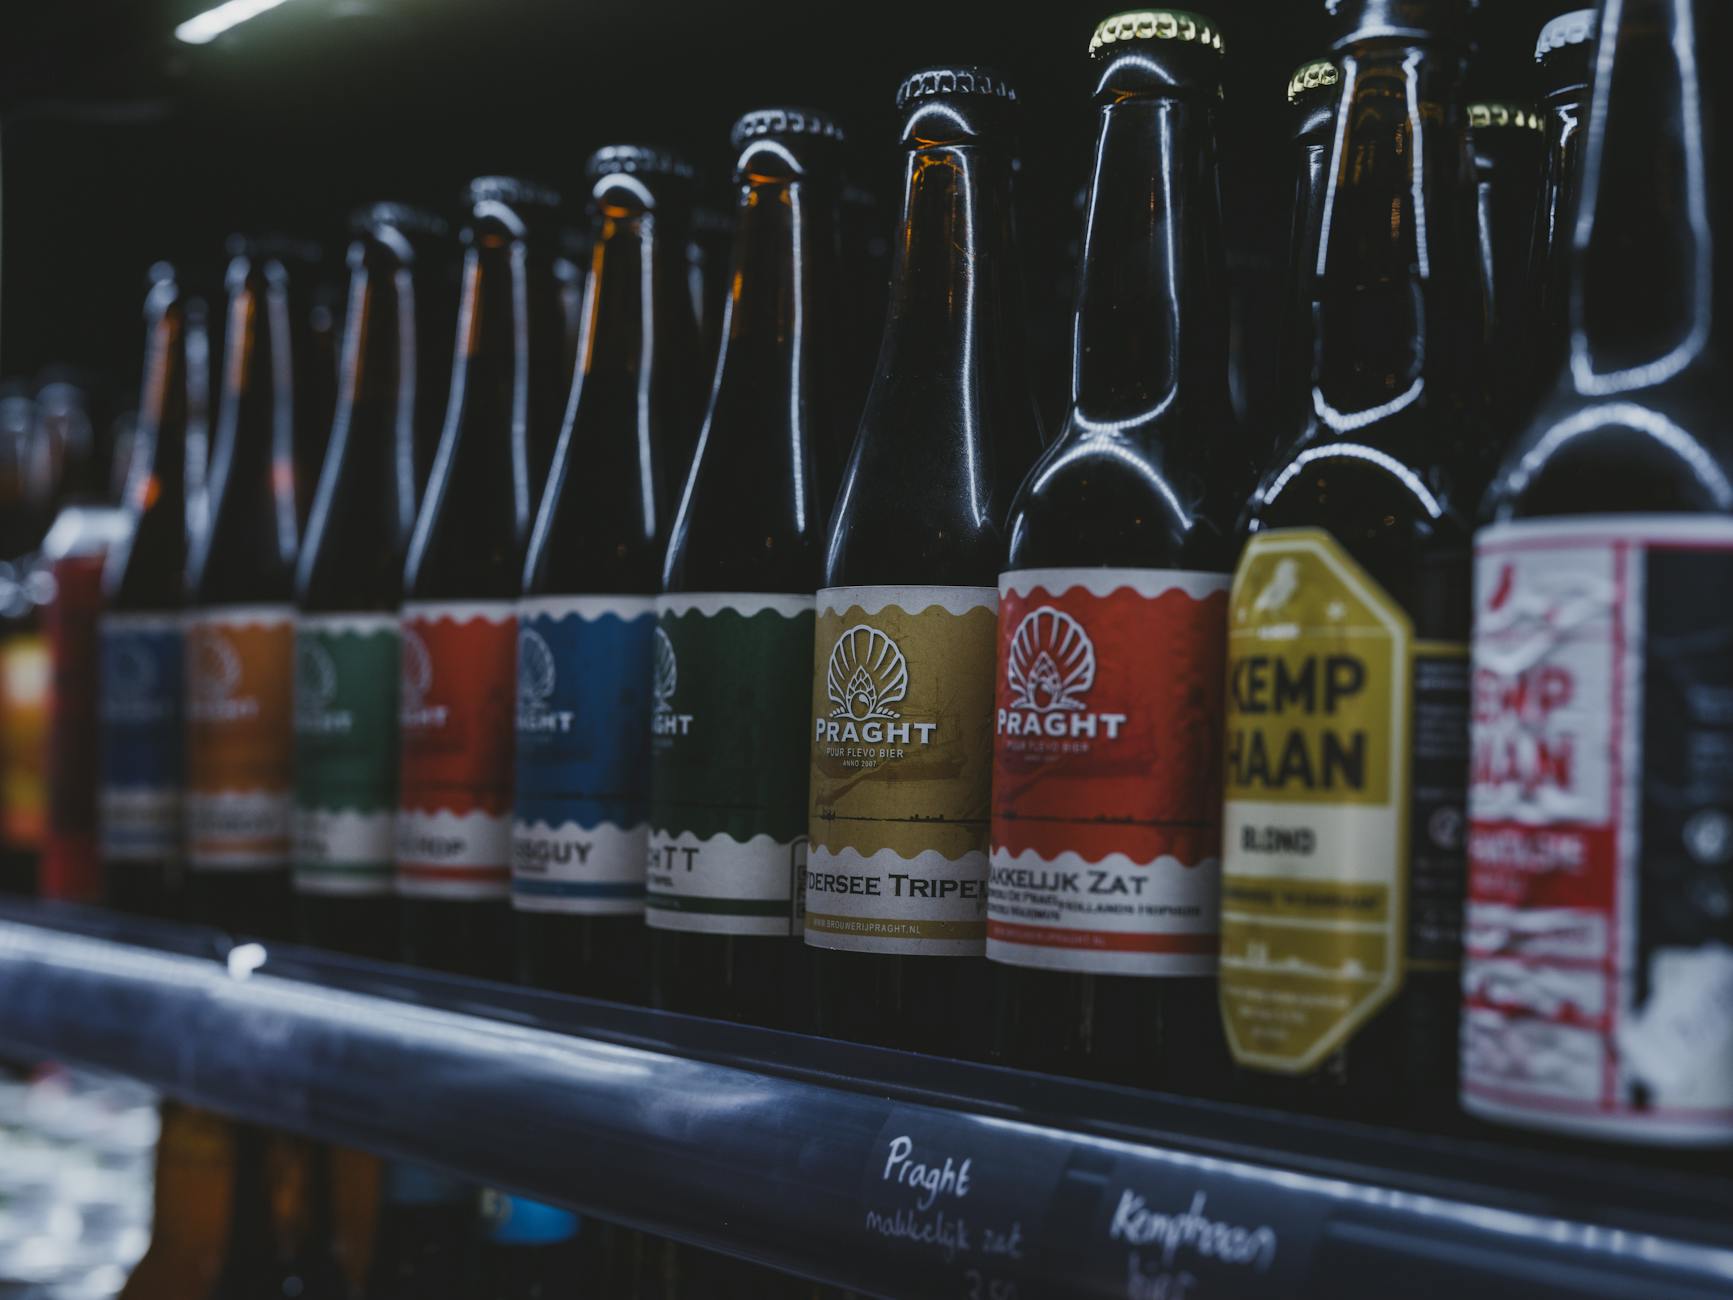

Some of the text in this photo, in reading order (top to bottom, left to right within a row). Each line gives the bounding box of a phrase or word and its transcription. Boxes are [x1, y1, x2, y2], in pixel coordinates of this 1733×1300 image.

[816, 718, 937, 744] PRAGHT
[997, 708, 1127, 739] PRAGHT
[827, 747, 904, 759] PUUR FLEVO BIER
[843, 760, 859, 768] ANNO
[807, 872, 881, 896] DERSEE
[989, 867, 1148, 896] AKKELIJK ZAT
[884, 1135, 972, 1210] Praght
